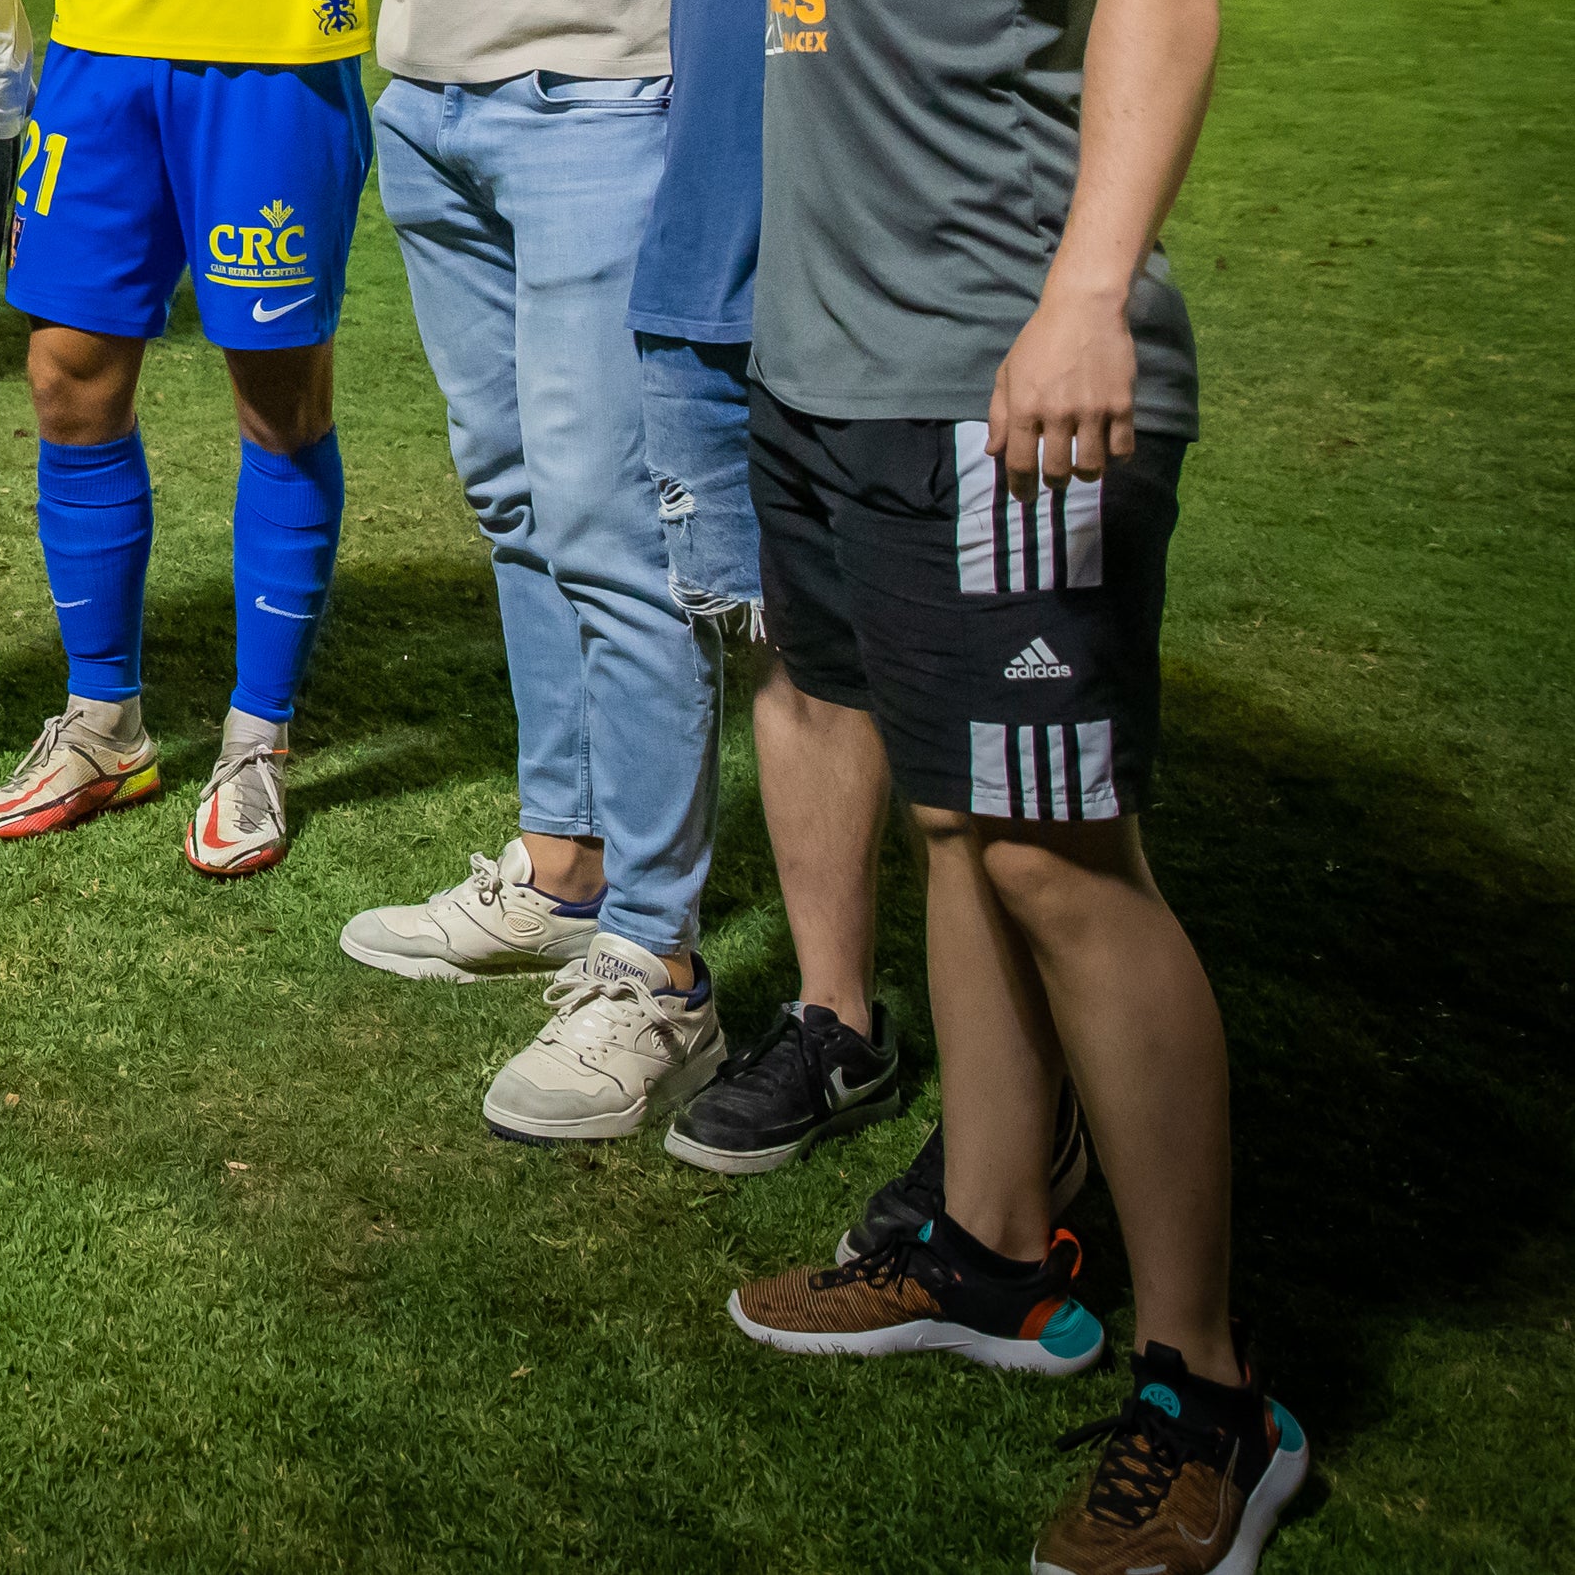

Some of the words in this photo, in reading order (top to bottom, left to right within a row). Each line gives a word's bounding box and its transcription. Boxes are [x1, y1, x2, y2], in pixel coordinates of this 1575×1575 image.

[209, 224, 307, 266] CRC
[228, 266, 262, 278] RURAL
[262, 266, 307, 278] CENTRAL
[1003, 660, 1073, 680] adidas
